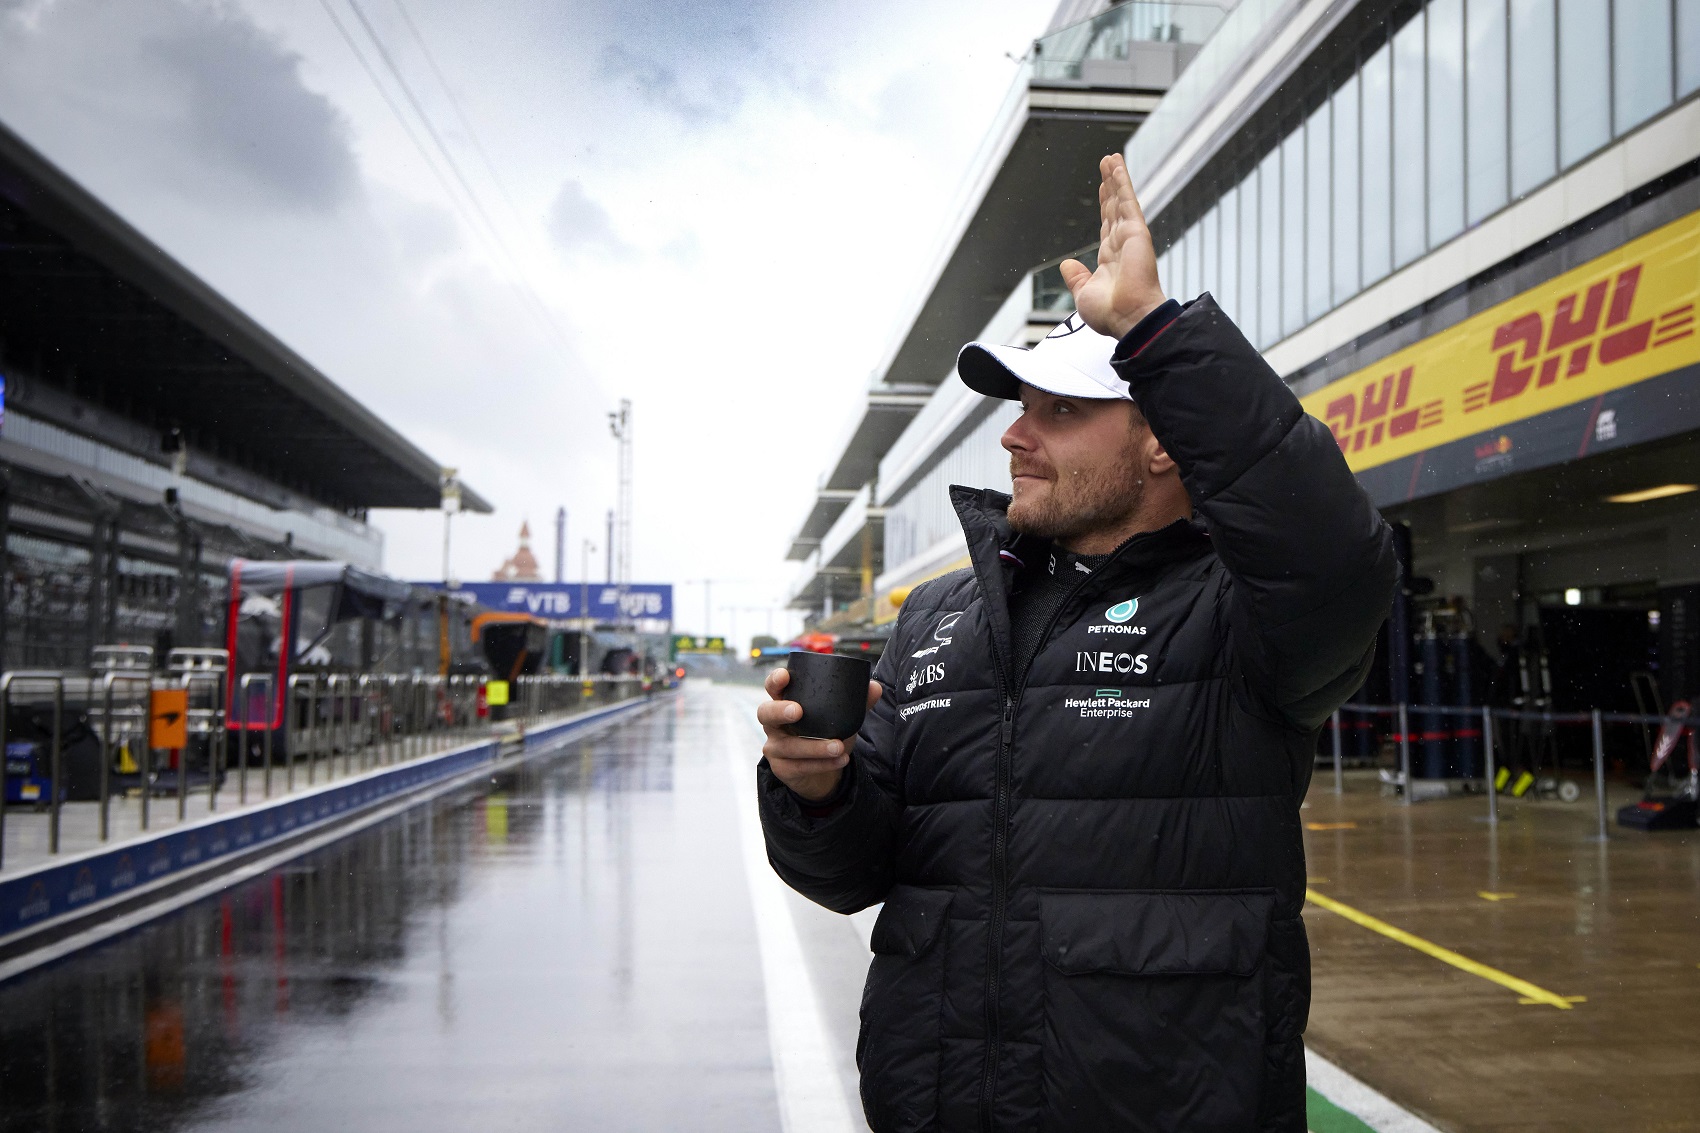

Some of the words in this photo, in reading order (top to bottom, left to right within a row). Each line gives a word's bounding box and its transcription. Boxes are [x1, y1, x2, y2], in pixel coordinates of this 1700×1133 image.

[1489, 264, 1654, 405] DHL
[1326, 365, 1420, 454] DHL
[527, 592, 571, 613] VTB
[1087, 625, 1147, 635] PETRONAS
[1075, 651, 1149, 674] INEOS
[918, 662, 945, 687] UBS
[903, 698, 951, 717] CROWDSTRIKE
[1065, 699, 1106, 708] Hewlett
[1107, 698, 1151, 708] Packard
[1080, 708, 1133, 719] Enterprise
